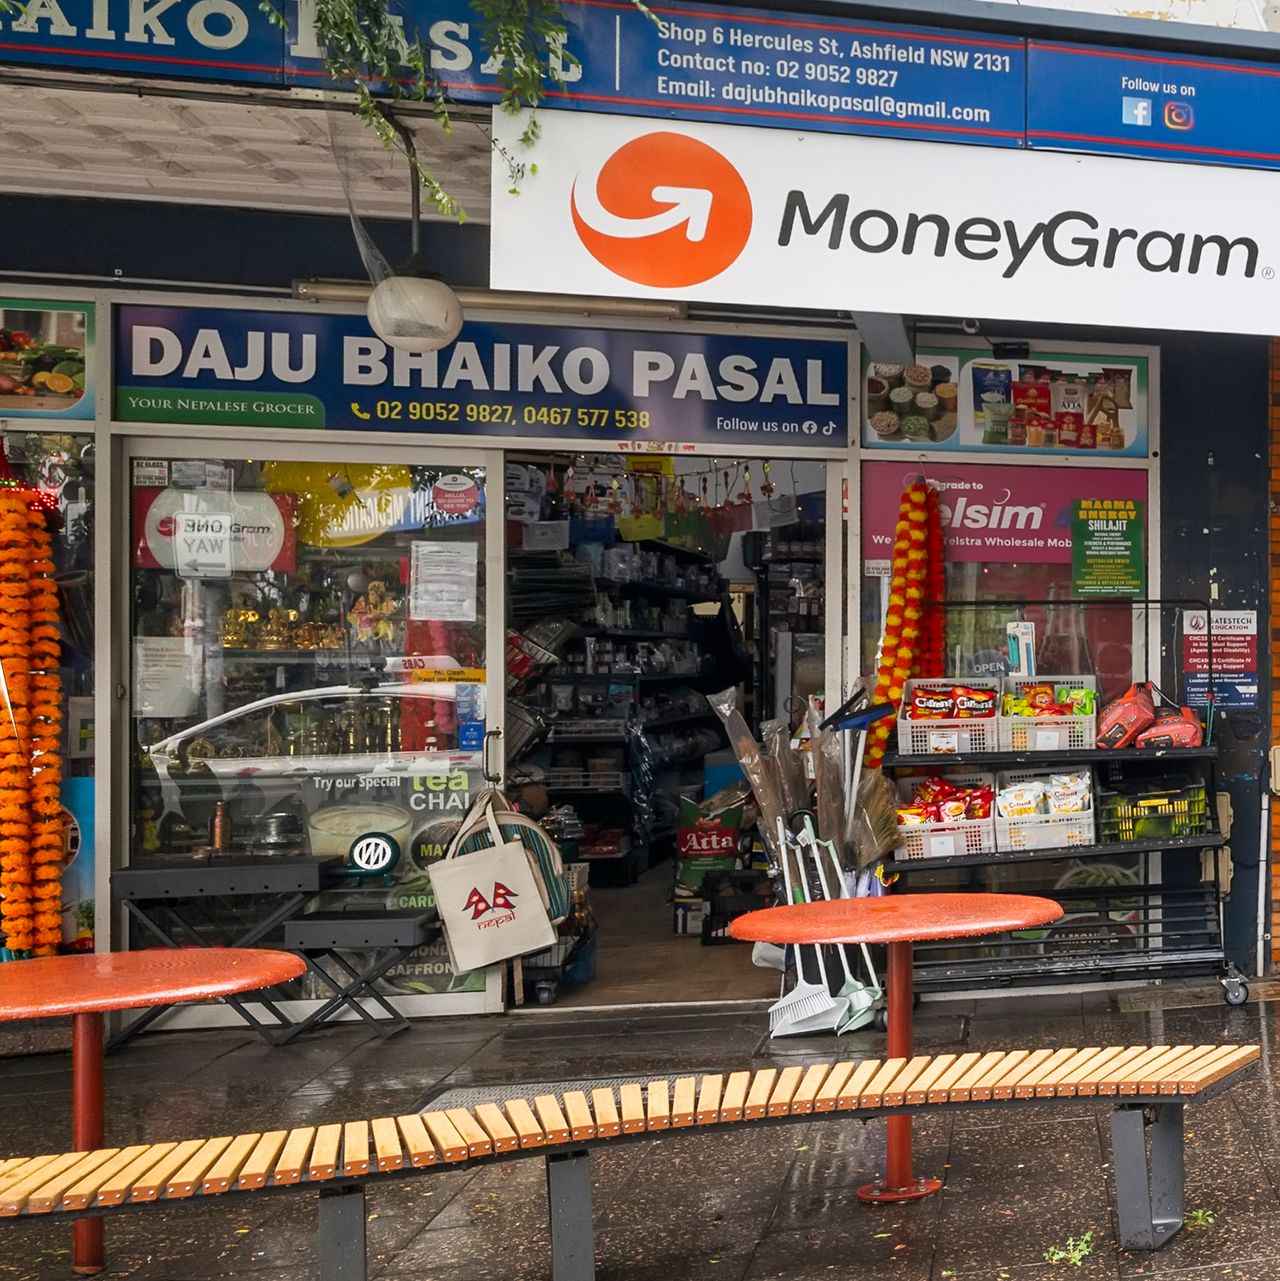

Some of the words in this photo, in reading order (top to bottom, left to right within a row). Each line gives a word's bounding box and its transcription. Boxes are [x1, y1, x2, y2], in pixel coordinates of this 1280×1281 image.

[658, 21, 707, 45] Shop
[712, 26, 724, 43] 6
[729, 28, 814, 53] Hercules
[819, 36, 845, 58] St,
[850, 40, 925, 65] Ashfield
[930, 50, 969, 69] NSW
[973, 53, 1010, 72] 2131
[657, 49, 736, 73] Contact
[741, 60, 771, 77] no:
[776, 60, 799, 79] 02
[804, 64, 851, 84] 9052
[855, 68, 899, 88] 9827
[1121, 76, 1159, 95] Follow
[1162, 82, 1177, 96] us
[1180, 83, 1197, 96] on
[656, 76, 716, 99] Email:
[722, 81, 991, 123] dajubhaikopasal@gmail.com
[777, 189, 1259, 280] MoneyGram
[131, 325, 317, 383] DAJU
[342, 342, 610, 397] BHAIKO
[632, 350, 840, 407] PASAL
[376, 400, 403, 420] 02
[408, 402, 458, 422] 9052
[465, 403, 518, 427] 9827,
[524, 406, 571, 426] 0467
[576, 408, 612, 427] 577
[615, 409, 651, 429] 538
[717, 417, 759, 432] Follow
[763, 421, 778, 432] us
[782, 422, 799, 433] on
[971, 481, 984, 490] to
[939, 488, 1045, 530] elsim
[1080, 500, 1135, 510] MAGMA
[1078, 510, 1137, 520] ENERGY
[1088, 520, 1128, 531] SHILAJIT
[872, 535, 893, 545] We
[985, 537, 1044, 548] Wholesale
[1048, 538, 1073, 548] Mob
[973, 661, 1005, 675] OPEN
[313, 776, 334, 792] Try
[336, 778, 356, 788] our
[359, 775, 401, 790] Special
[409, 792, 470, 811] CHAI
[477, 909, 516, 930] nepal
[385, 962, 454, 977] SAFFRON
